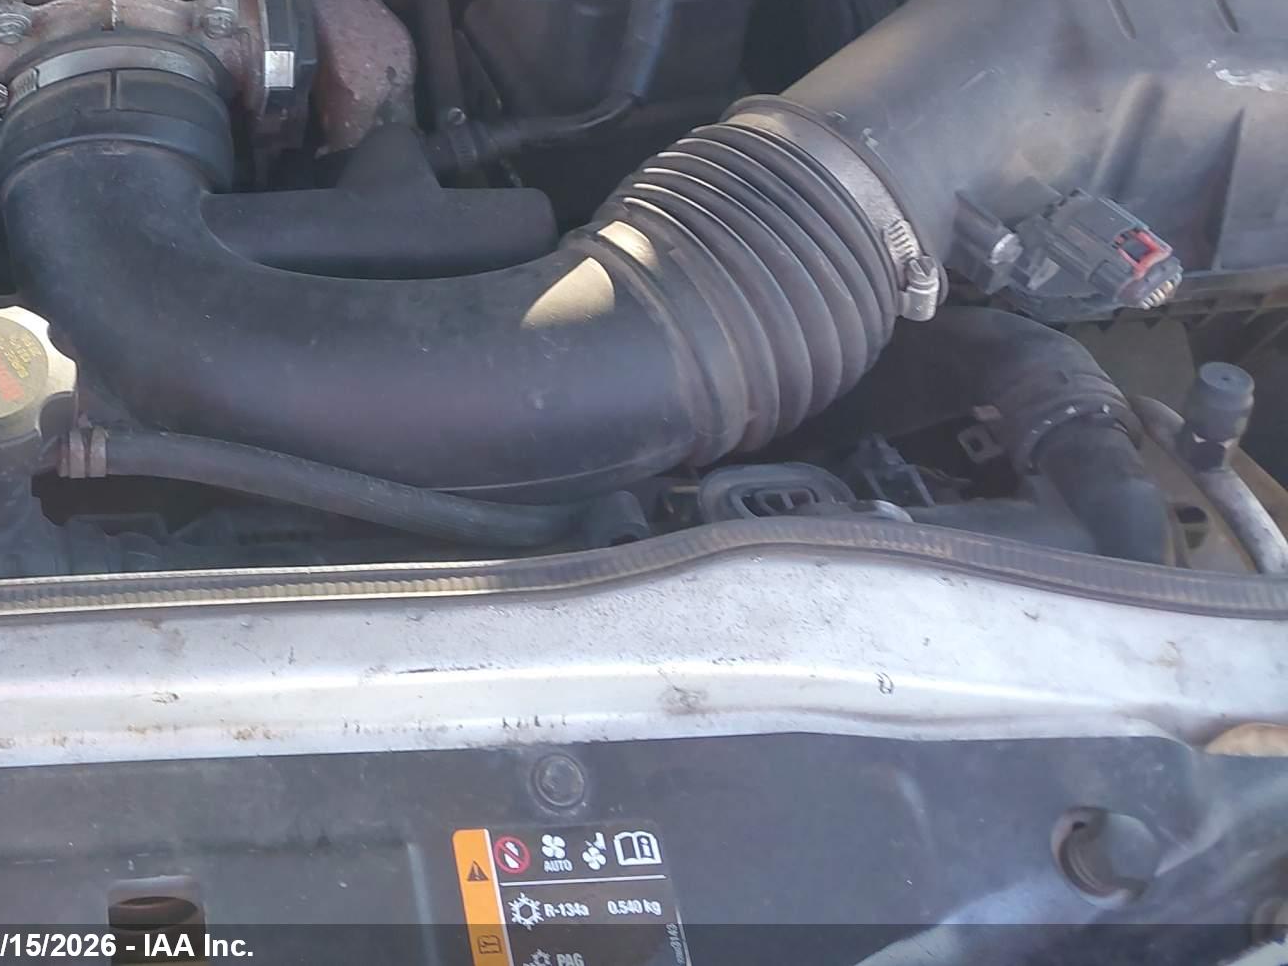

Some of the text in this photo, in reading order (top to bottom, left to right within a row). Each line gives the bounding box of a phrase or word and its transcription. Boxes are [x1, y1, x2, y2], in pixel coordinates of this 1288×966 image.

[544, 859, 573, 872] AUTO
[544, 899, 662, 917] R-134a 0.540 kg
[556, 952, 585, 966] PAG
